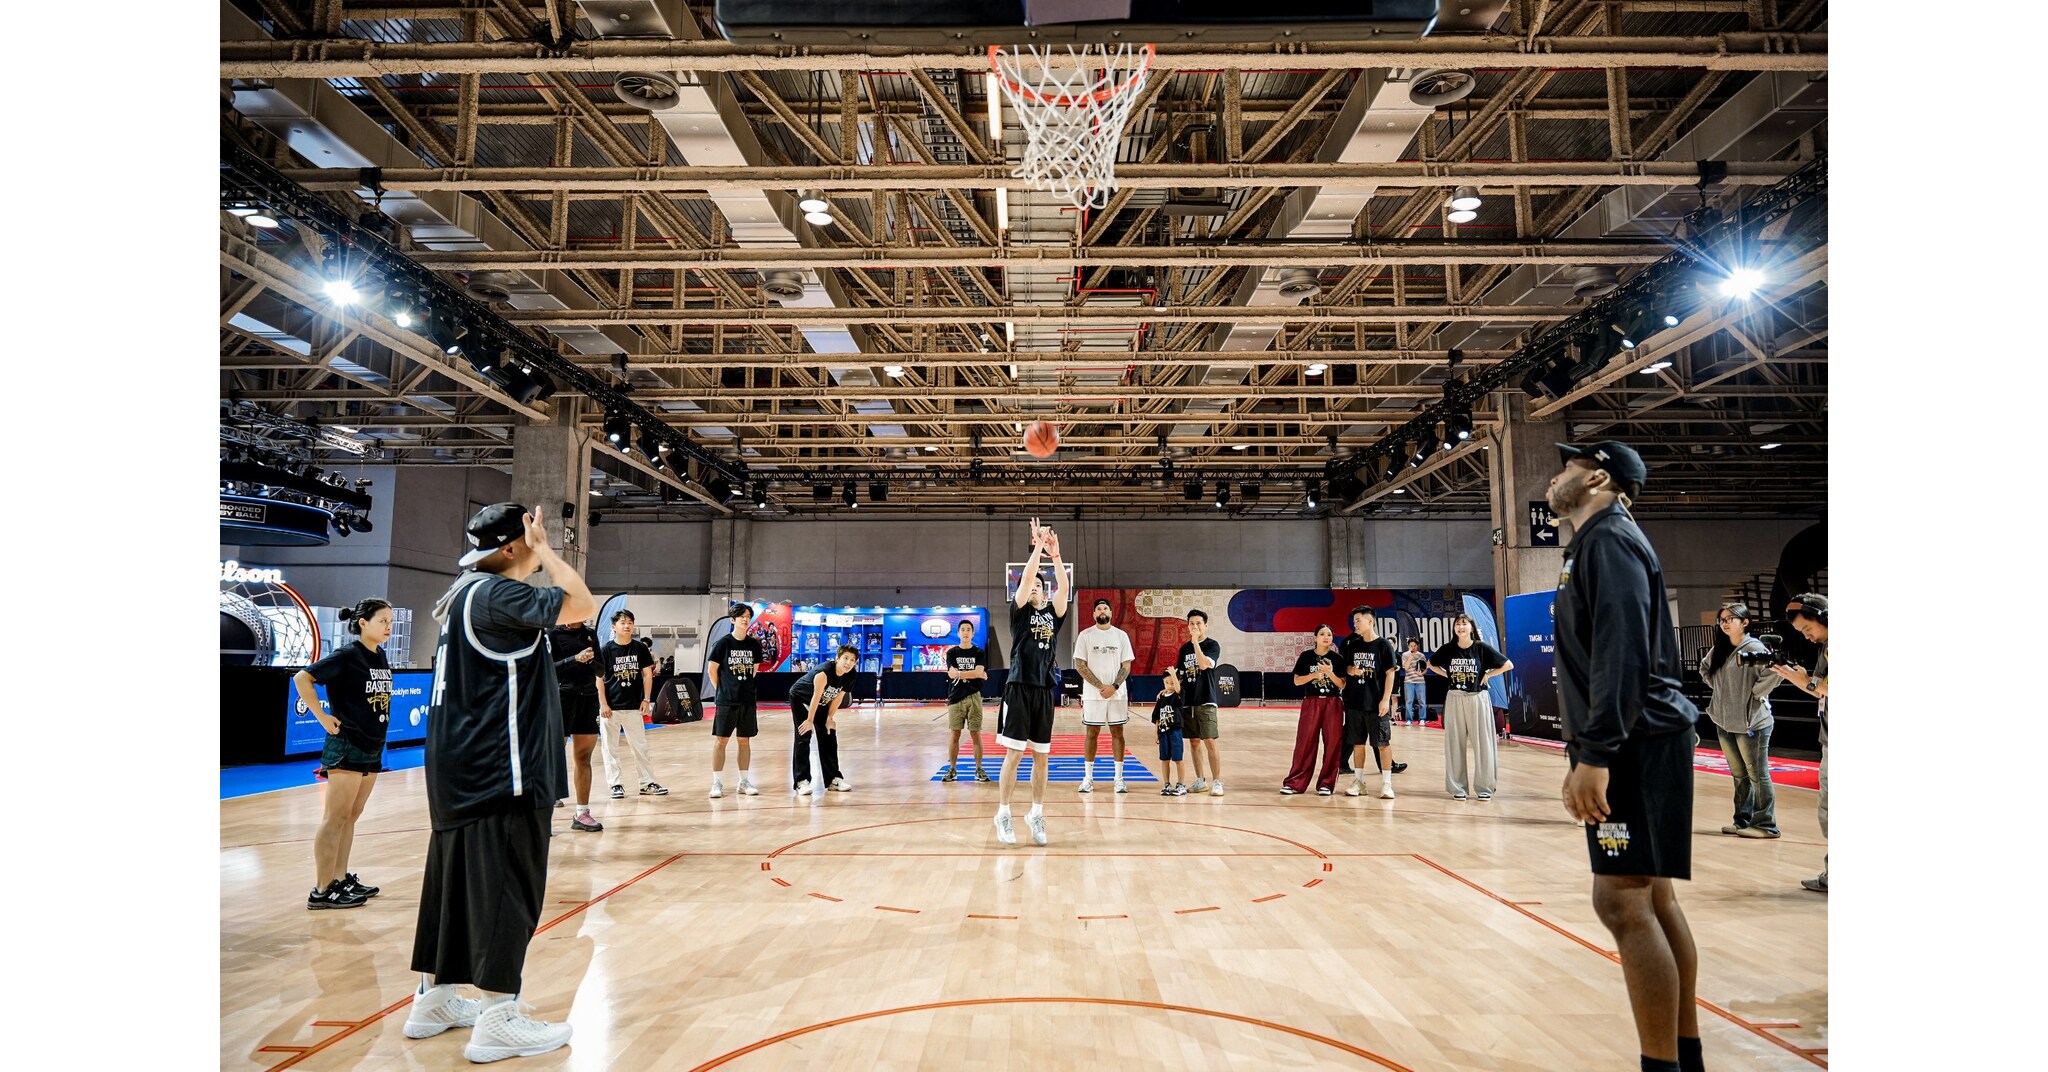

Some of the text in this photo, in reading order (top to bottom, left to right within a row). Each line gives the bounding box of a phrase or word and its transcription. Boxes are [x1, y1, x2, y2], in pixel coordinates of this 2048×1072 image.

[220, 504, 262, 513] BONDED
[235, 511, 261, 519] BALL
[1416, 617, 1455, 652] HOU
[730, 650, 753, 658] BROOKLYN
[615, 655, 638, 664] BROOKLYN
[1451, 658, 1476, 666] BROOKLYN
[613, 662, 640, 672] BASKETBALL
[410, 687, 422, 695] Nets
[328, 891, 341, 901] N
